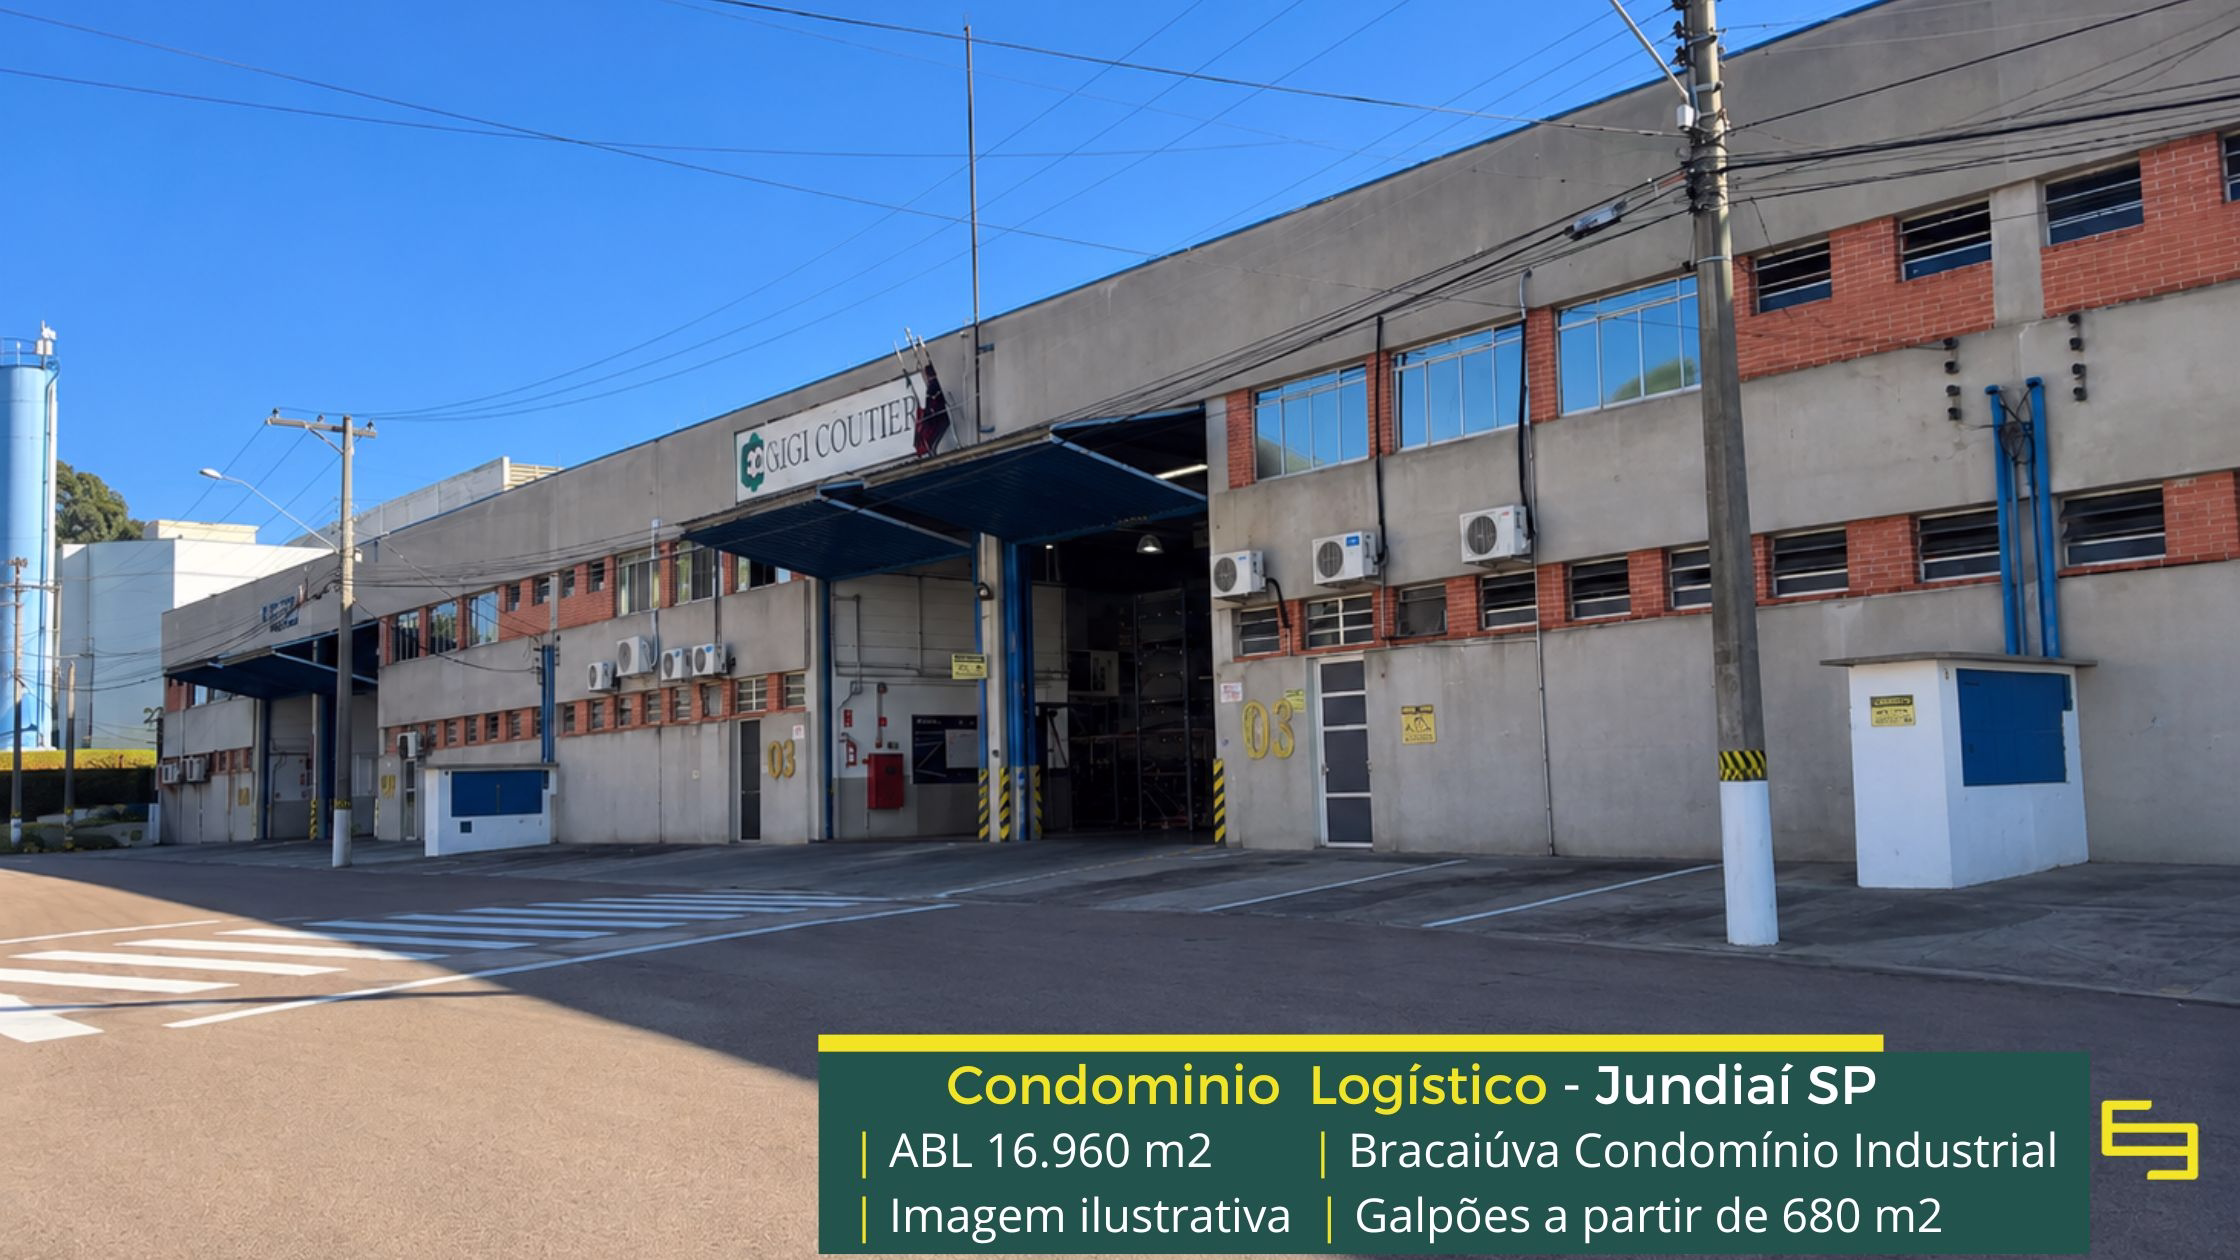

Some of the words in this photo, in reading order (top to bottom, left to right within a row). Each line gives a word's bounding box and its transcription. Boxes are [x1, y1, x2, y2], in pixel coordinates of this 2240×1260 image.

[765, 428, 810, 473] GIGI
[815, 394, 917, 458] COUTIER
[767, 739, 796, 780] 03
[1242, 699, 1295, 760] 03
